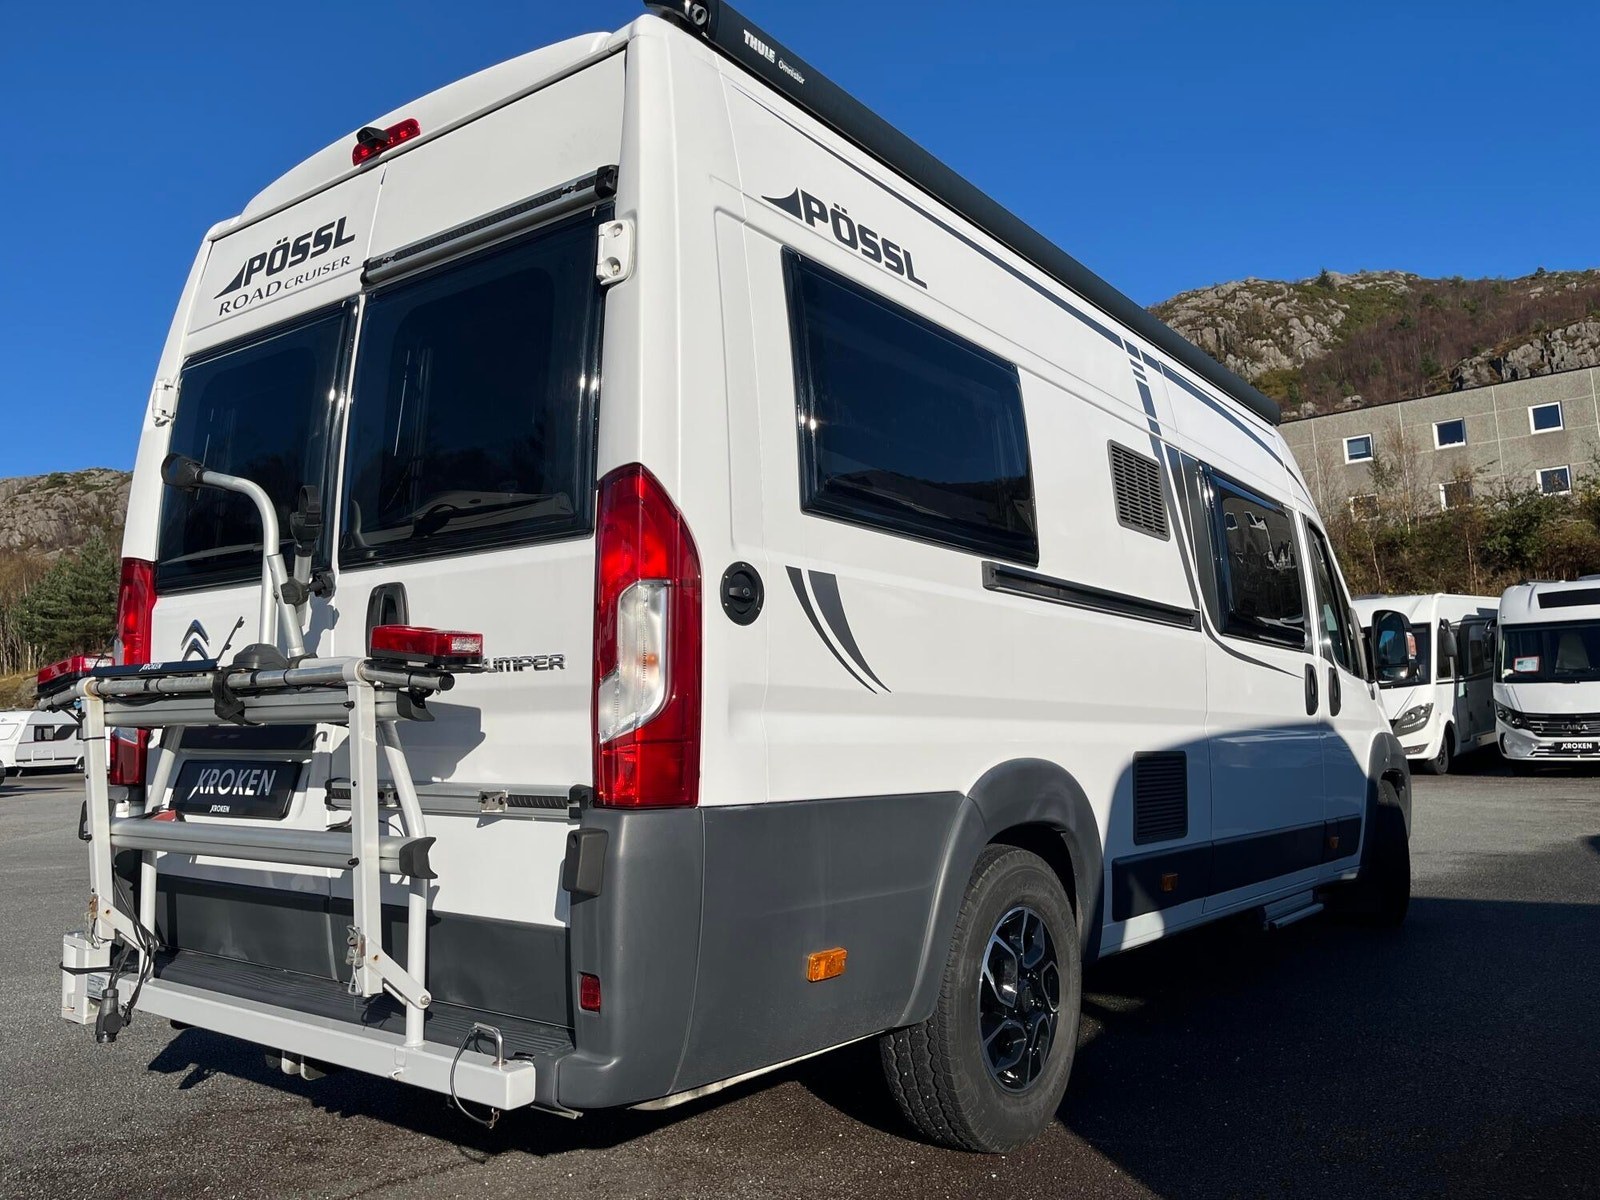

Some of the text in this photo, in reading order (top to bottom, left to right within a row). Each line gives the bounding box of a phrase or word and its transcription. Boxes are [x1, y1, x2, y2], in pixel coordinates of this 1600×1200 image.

[743, 28, 806, 85] THULE Omnistor
[243, 216, 356, 287] PÖSSL
[800, 189, 928, 290] PÖSSL
[218, 255, 351, 317] ROAD CRUISER
[482, 653, 565, 674] UMPER
[1560, 742, 1593, 751] KROKEN
[187, 768, 277, 801] KROKEN
[209, 804, 231, 814] KROKEN
